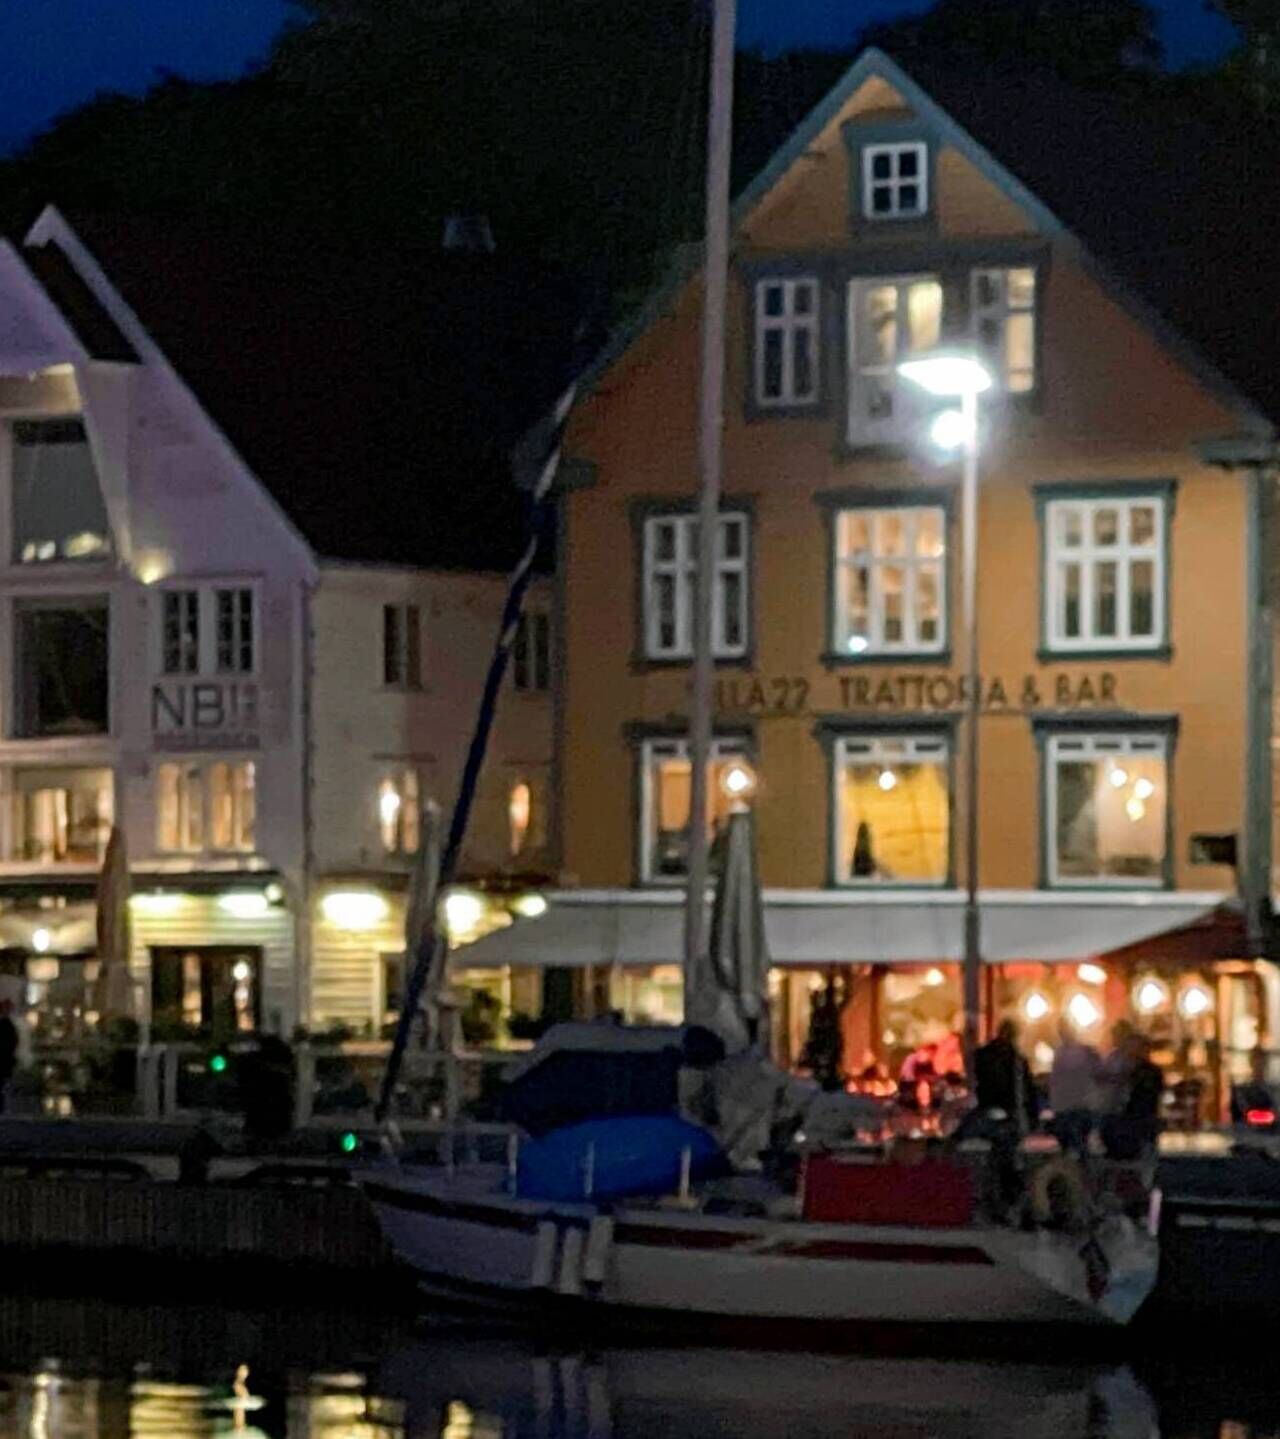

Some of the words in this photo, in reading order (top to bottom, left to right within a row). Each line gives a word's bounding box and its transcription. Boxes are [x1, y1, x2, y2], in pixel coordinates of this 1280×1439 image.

[839, 673, 1007, 708] TRATTORA
[1022, 673, 1040, 704] &
[1055, 671, 1117, 703] BAR
